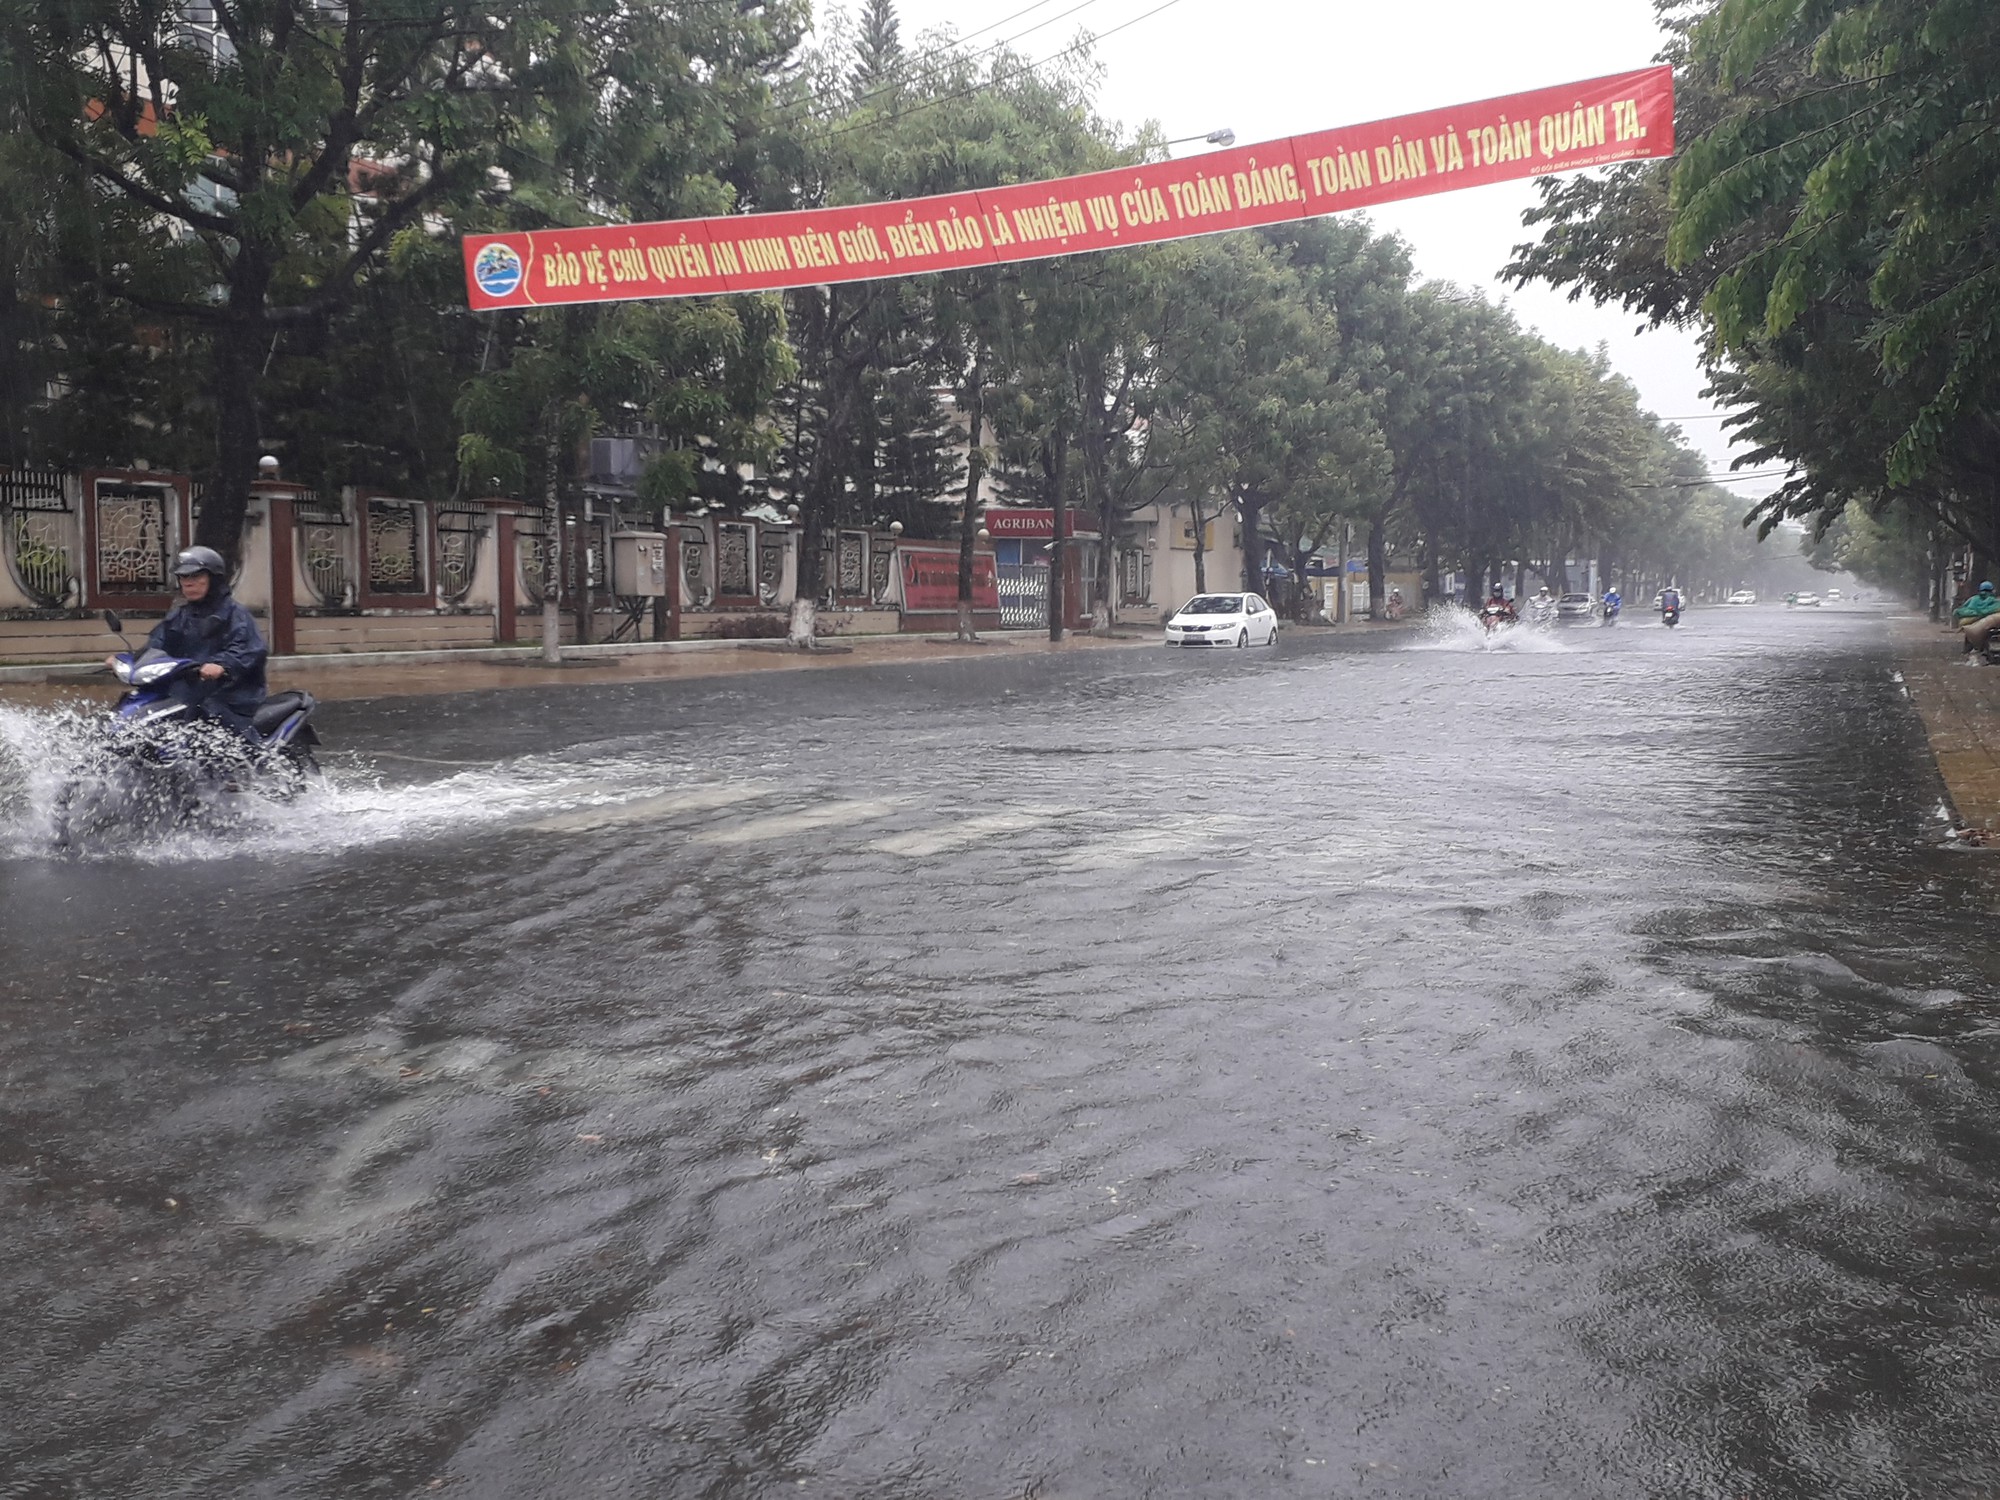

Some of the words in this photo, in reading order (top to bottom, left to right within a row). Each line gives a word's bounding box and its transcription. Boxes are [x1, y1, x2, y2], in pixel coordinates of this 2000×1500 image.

[542, 242, 581, 287] BẢO
[581, 244, 608, 292] VỆ
[608, 236, 649, 282] CHỦ
[648, 233, 711, 283] QUYỀN
[709, 240, 742, 275] AN
[738, 237, 791, 273] NINH
[787, 227, 839, 268] BIÊN
[837, 221, 890, 264] GIỚI,
[885, 209, 939, 258] BIỂN
[936, 206, 984, 252] ĐẢO
[982, 205, 1015, 247] LÀ
[1012, 197, 1088, 245] NHIỆM
[1086, 194, 1119, 237] VỤ
[1121, 177, 1170, 227] CỦA
[1168, 171, 1232, 218] TOÀN
[1233, 157, 1307, 209] ĐẢNG,
[1306, 145, 1372, 197] TOÀN
[1374, 134, 1427, 185] DÂN
[1429, 124, 1464, 174] VÀ
[1467, 115, 1532, 168] TOÀN
[1538, 100, 1605, 159] QUÂN
[1611, 98, 1647, 142] TA.
[993, 518, 1055, 529] AGRIBAN
